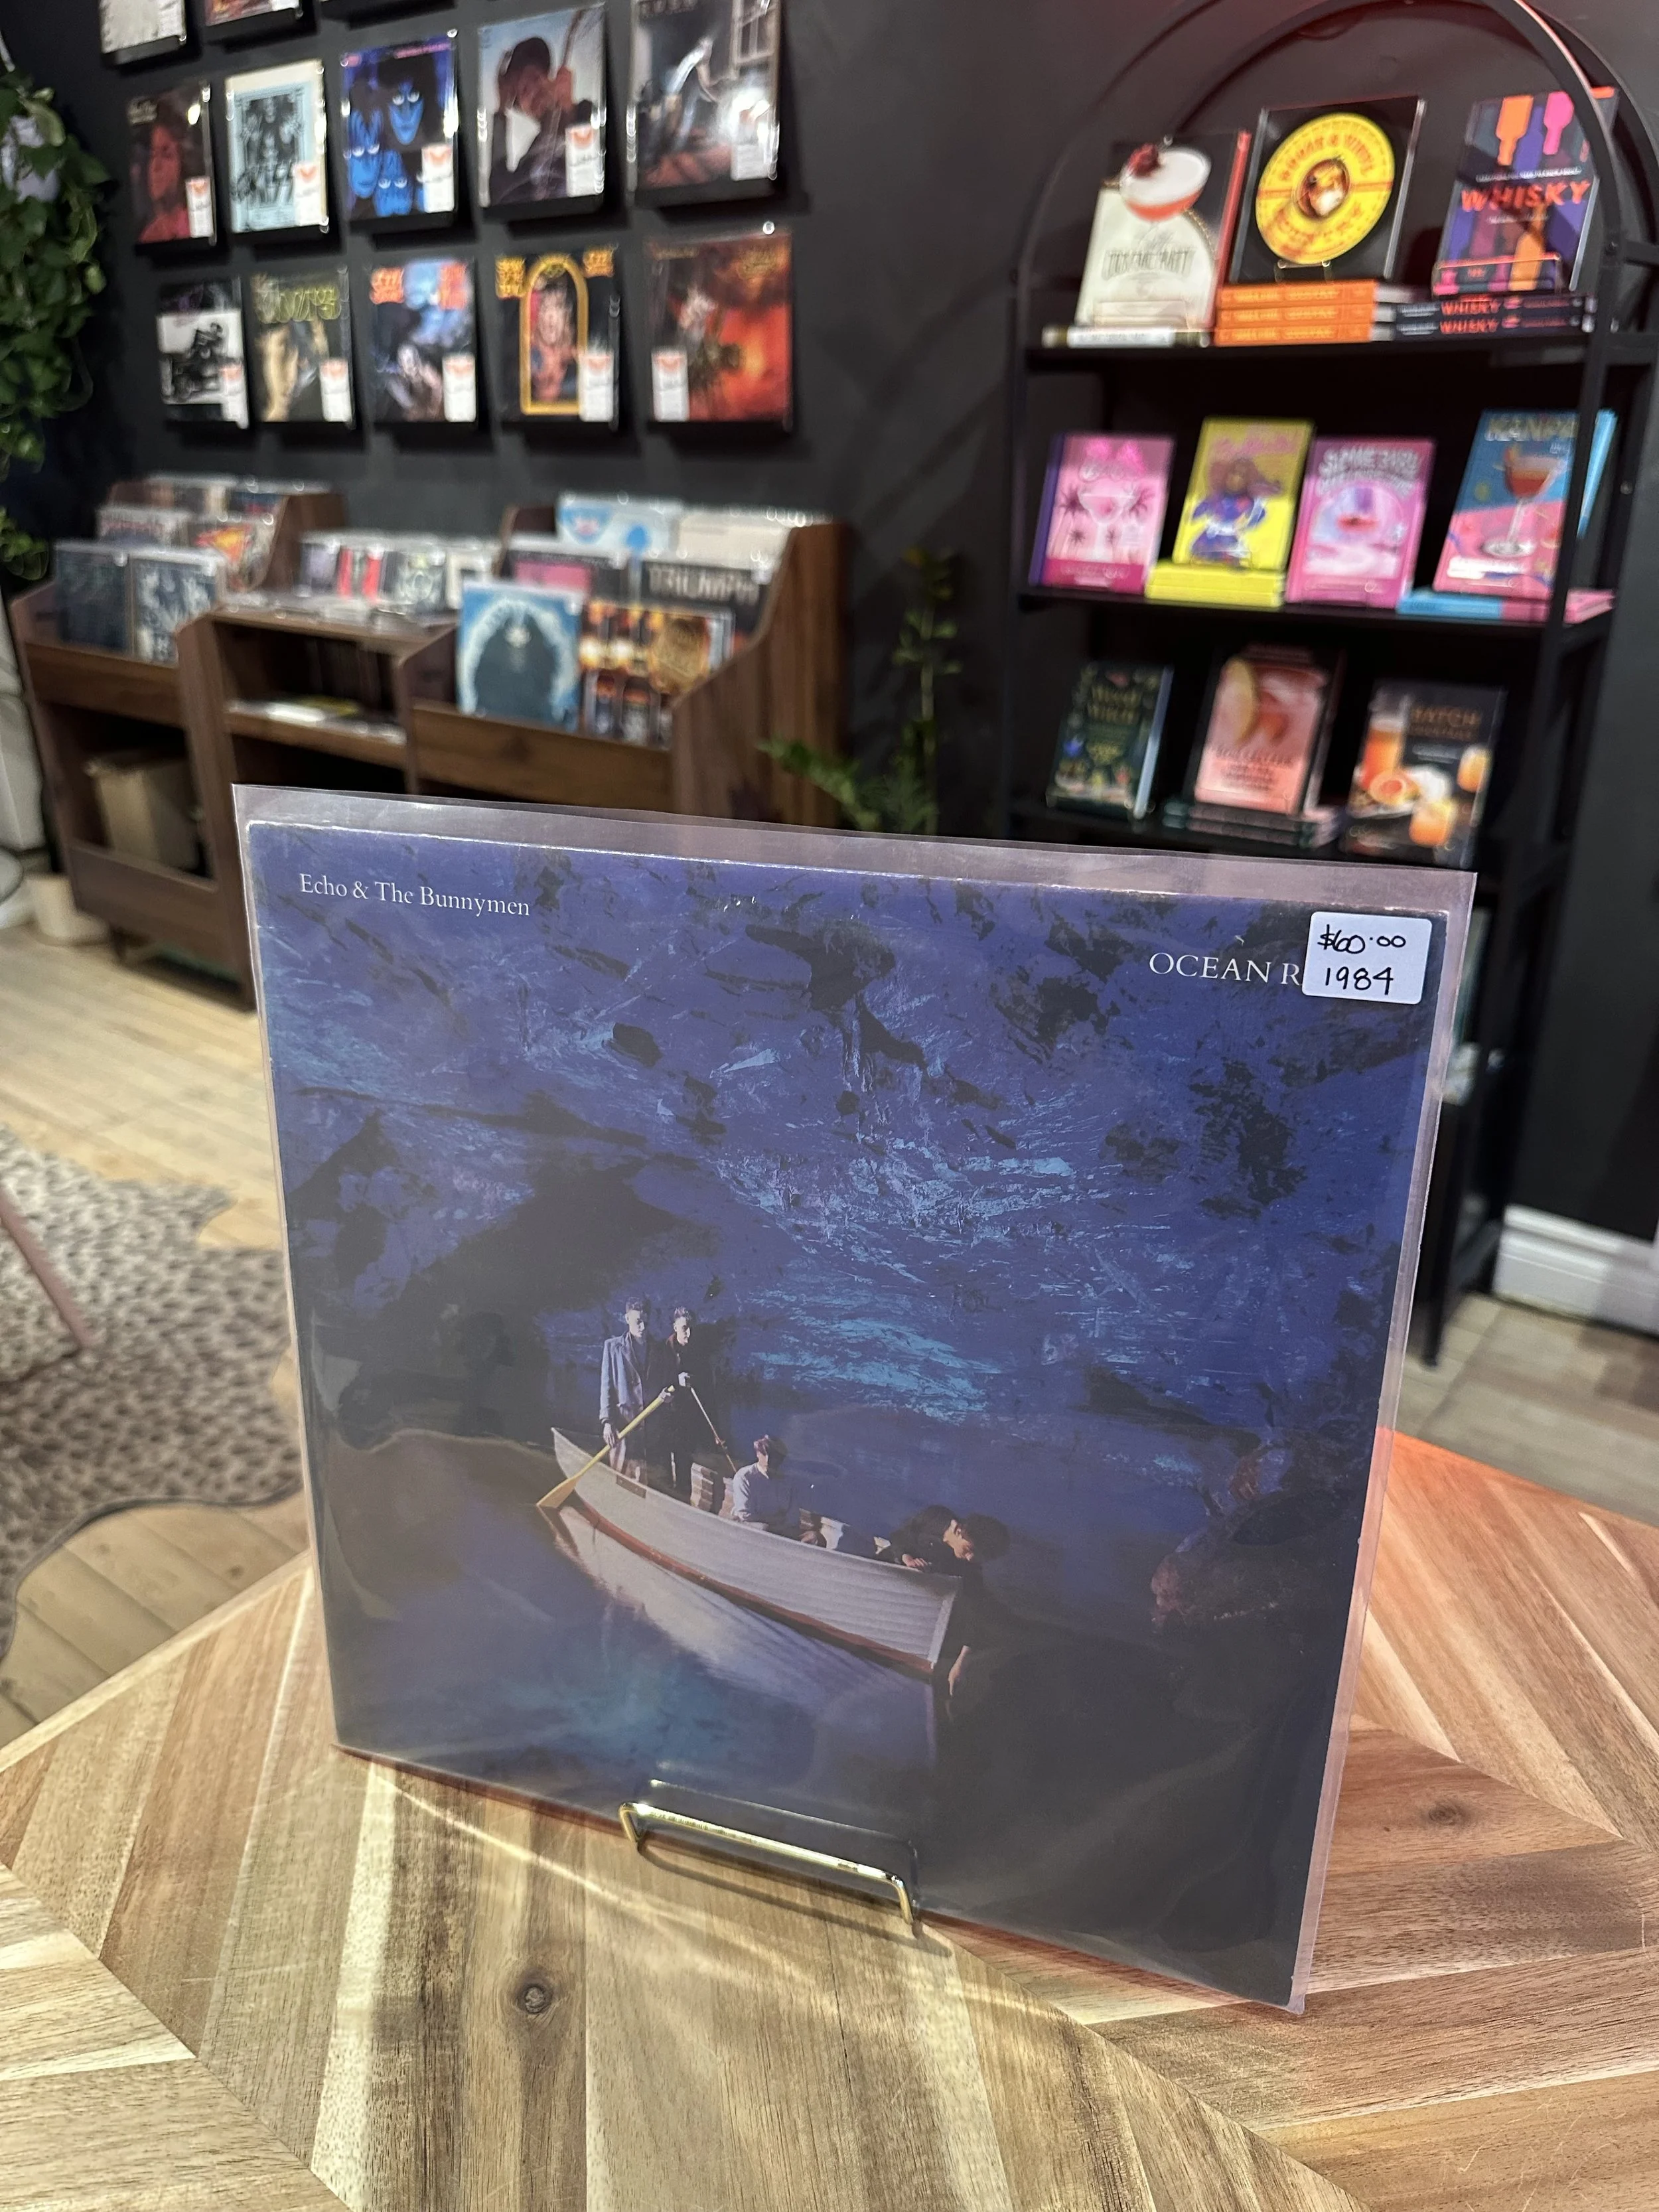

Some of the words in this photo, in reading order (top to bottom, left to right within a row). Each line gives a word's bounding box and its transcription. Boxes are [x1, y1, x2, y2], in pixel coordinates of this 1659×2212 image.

[1461, 180, 1591, 212] WHISKY
[1441, 298, 1501, 317] WHISKY
[1439, 317, 1498, 334] WHISKY
[300, 873, 347, 897] Echo
[352, 881, 369, 900] &
[374, 881, 413, 905] The
[419, 886, 530, 917] Bunnymen
[1149, 952, 1271, 984] OCEAN
[1325, 966, 1394, 995] 1984
